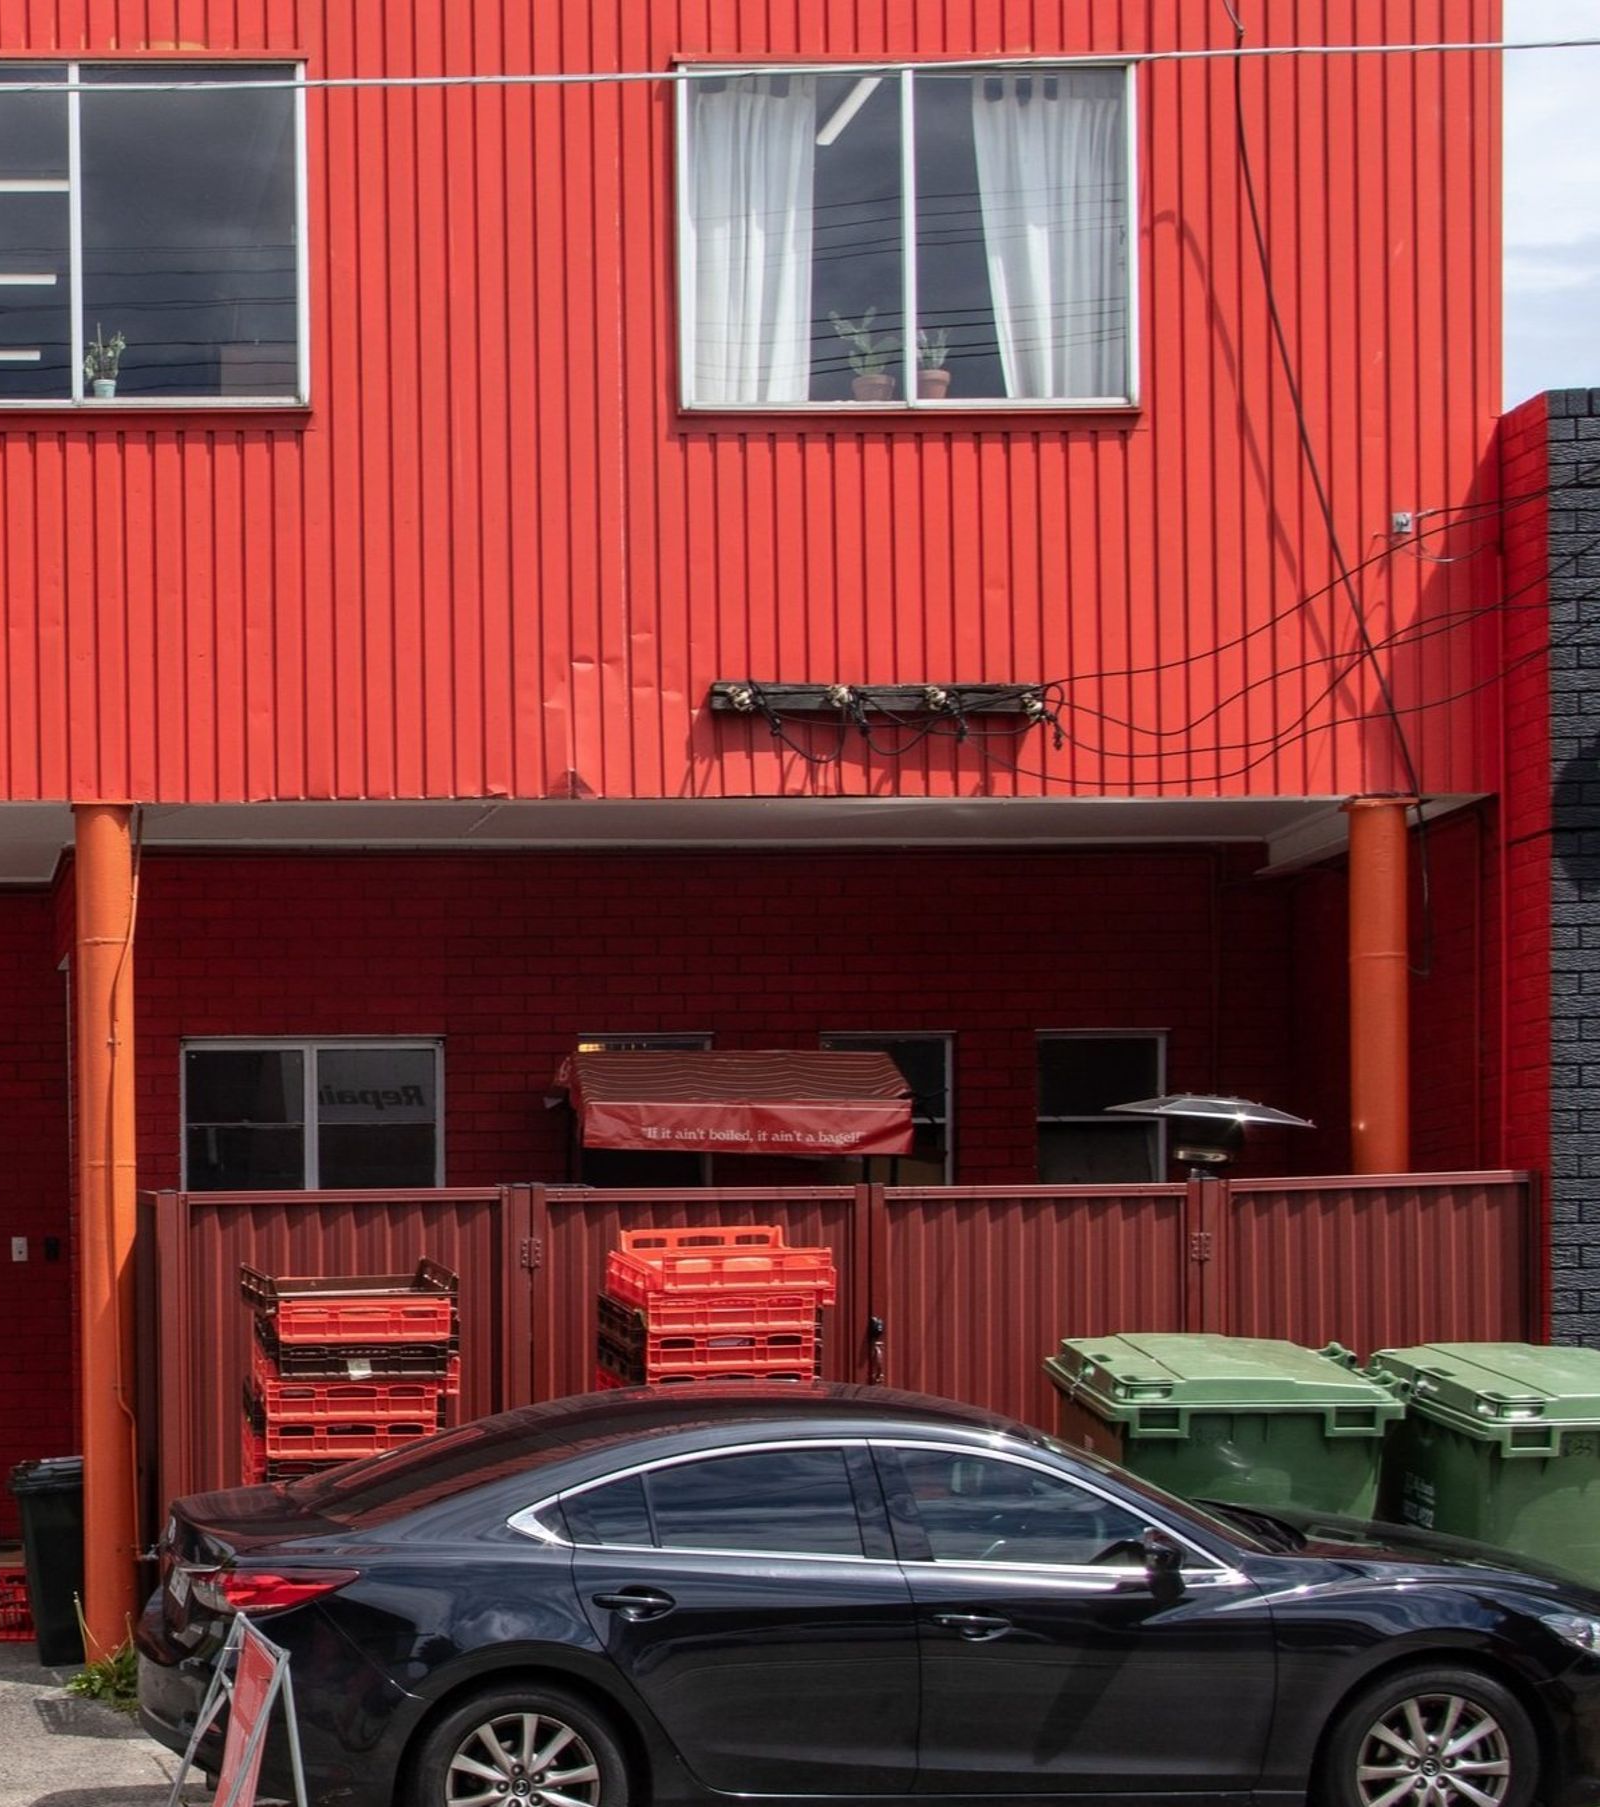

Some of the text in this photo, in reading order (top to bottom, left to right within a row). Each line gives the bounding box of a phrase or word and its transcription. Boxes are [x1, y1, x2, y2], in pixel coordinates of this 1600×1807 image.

[661, 1128, 672, 1139] it
[675, 1128, 705, 1140] ain't
[709, 1129, 753, 1143] boiled,
[757, 1130, 769, 1141] it
[771, 1130, 802, 1142] ain't
[805, 1133, 815, 1142] a
